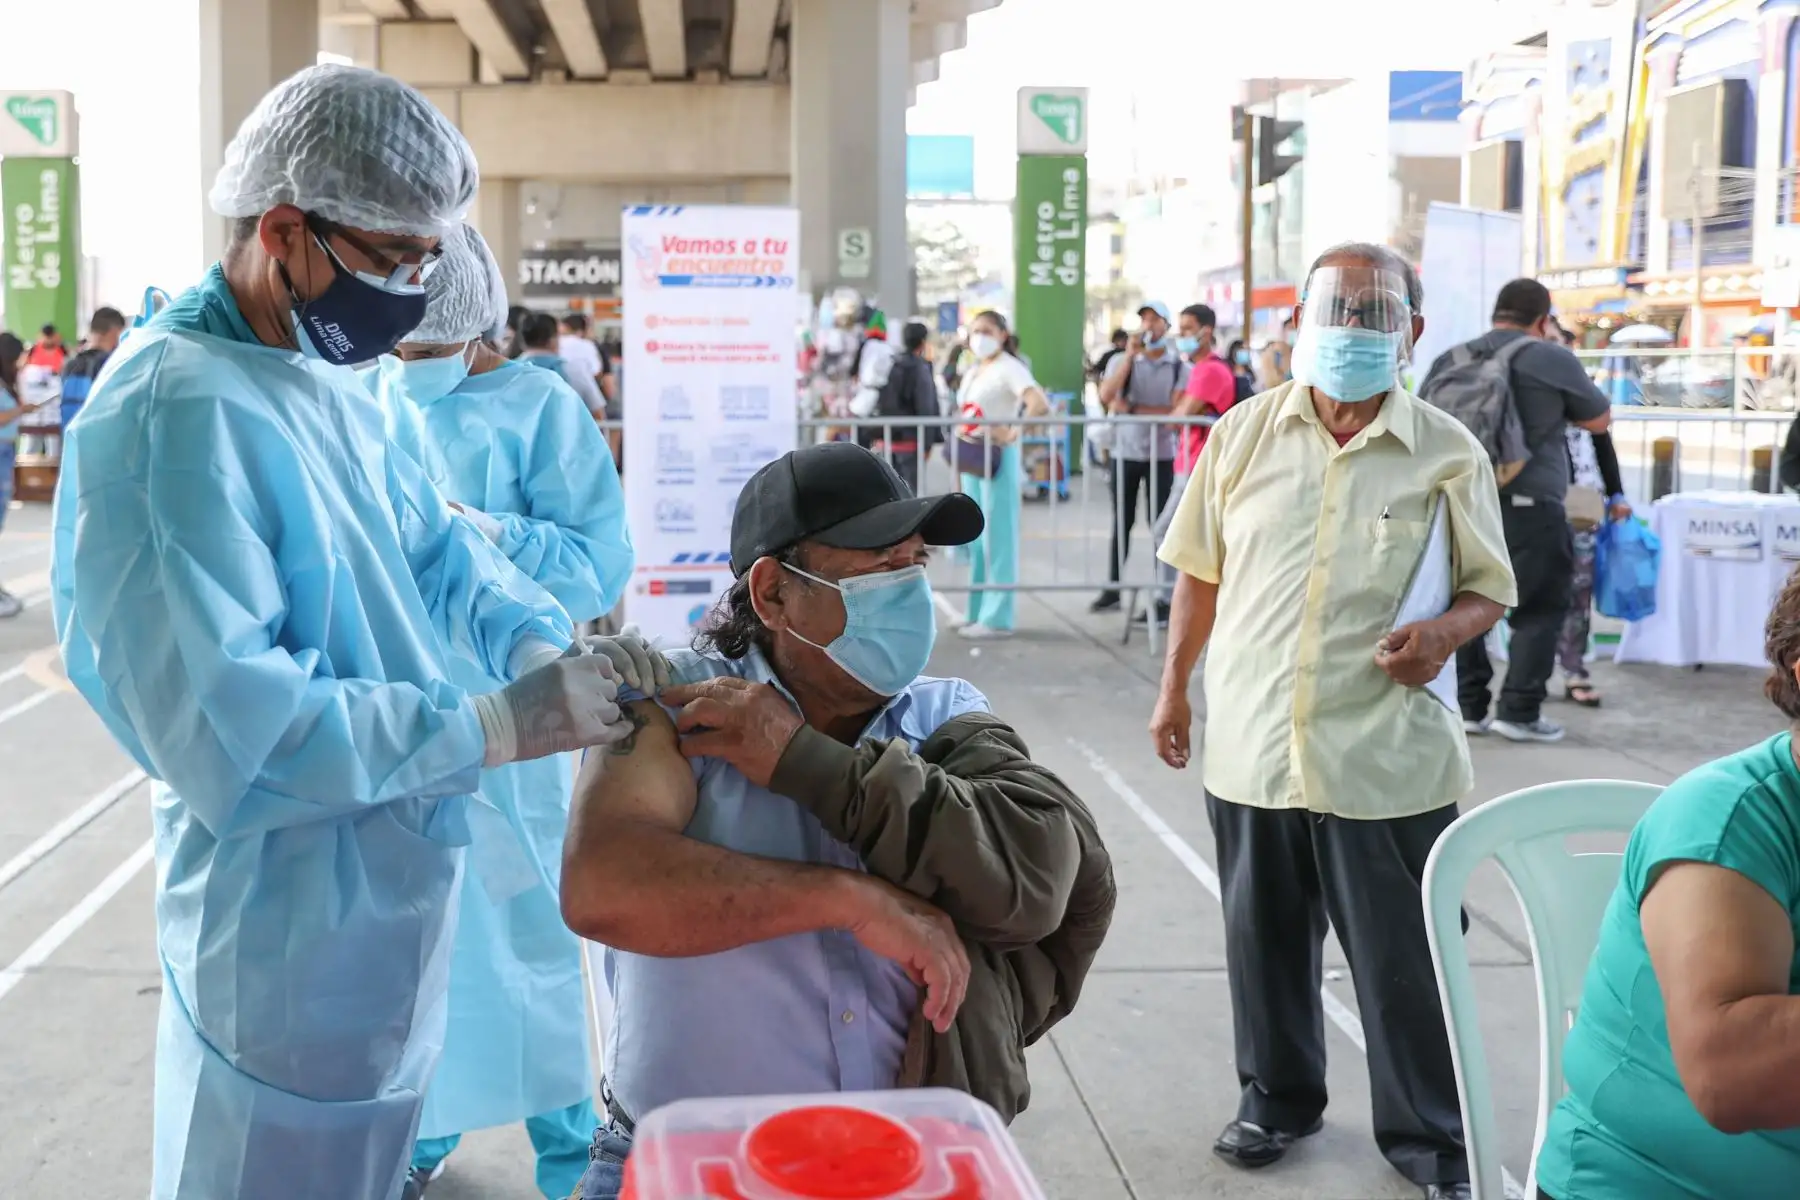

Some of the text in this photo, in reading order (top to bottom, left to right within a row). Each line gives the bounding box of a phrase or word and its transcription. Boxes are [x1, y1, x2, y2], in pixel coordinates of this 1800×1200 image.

[9, 203, 36, 289] Metro
[36, 168, 61, 289] de Lima
[661, 235, 788, 255] Vamos a tu
[844, 231, 864, 258] S
[1028, 200, 1056, 287] Metro
[1054, 167, 1081, 287] de Lima
[667, 256, 784, 274] encuentro
[310, 315, 345, 361] Lima Centro
[324, 321, 354, 353] DIRIS
[1688, 519, 1757, 538] MINSA
